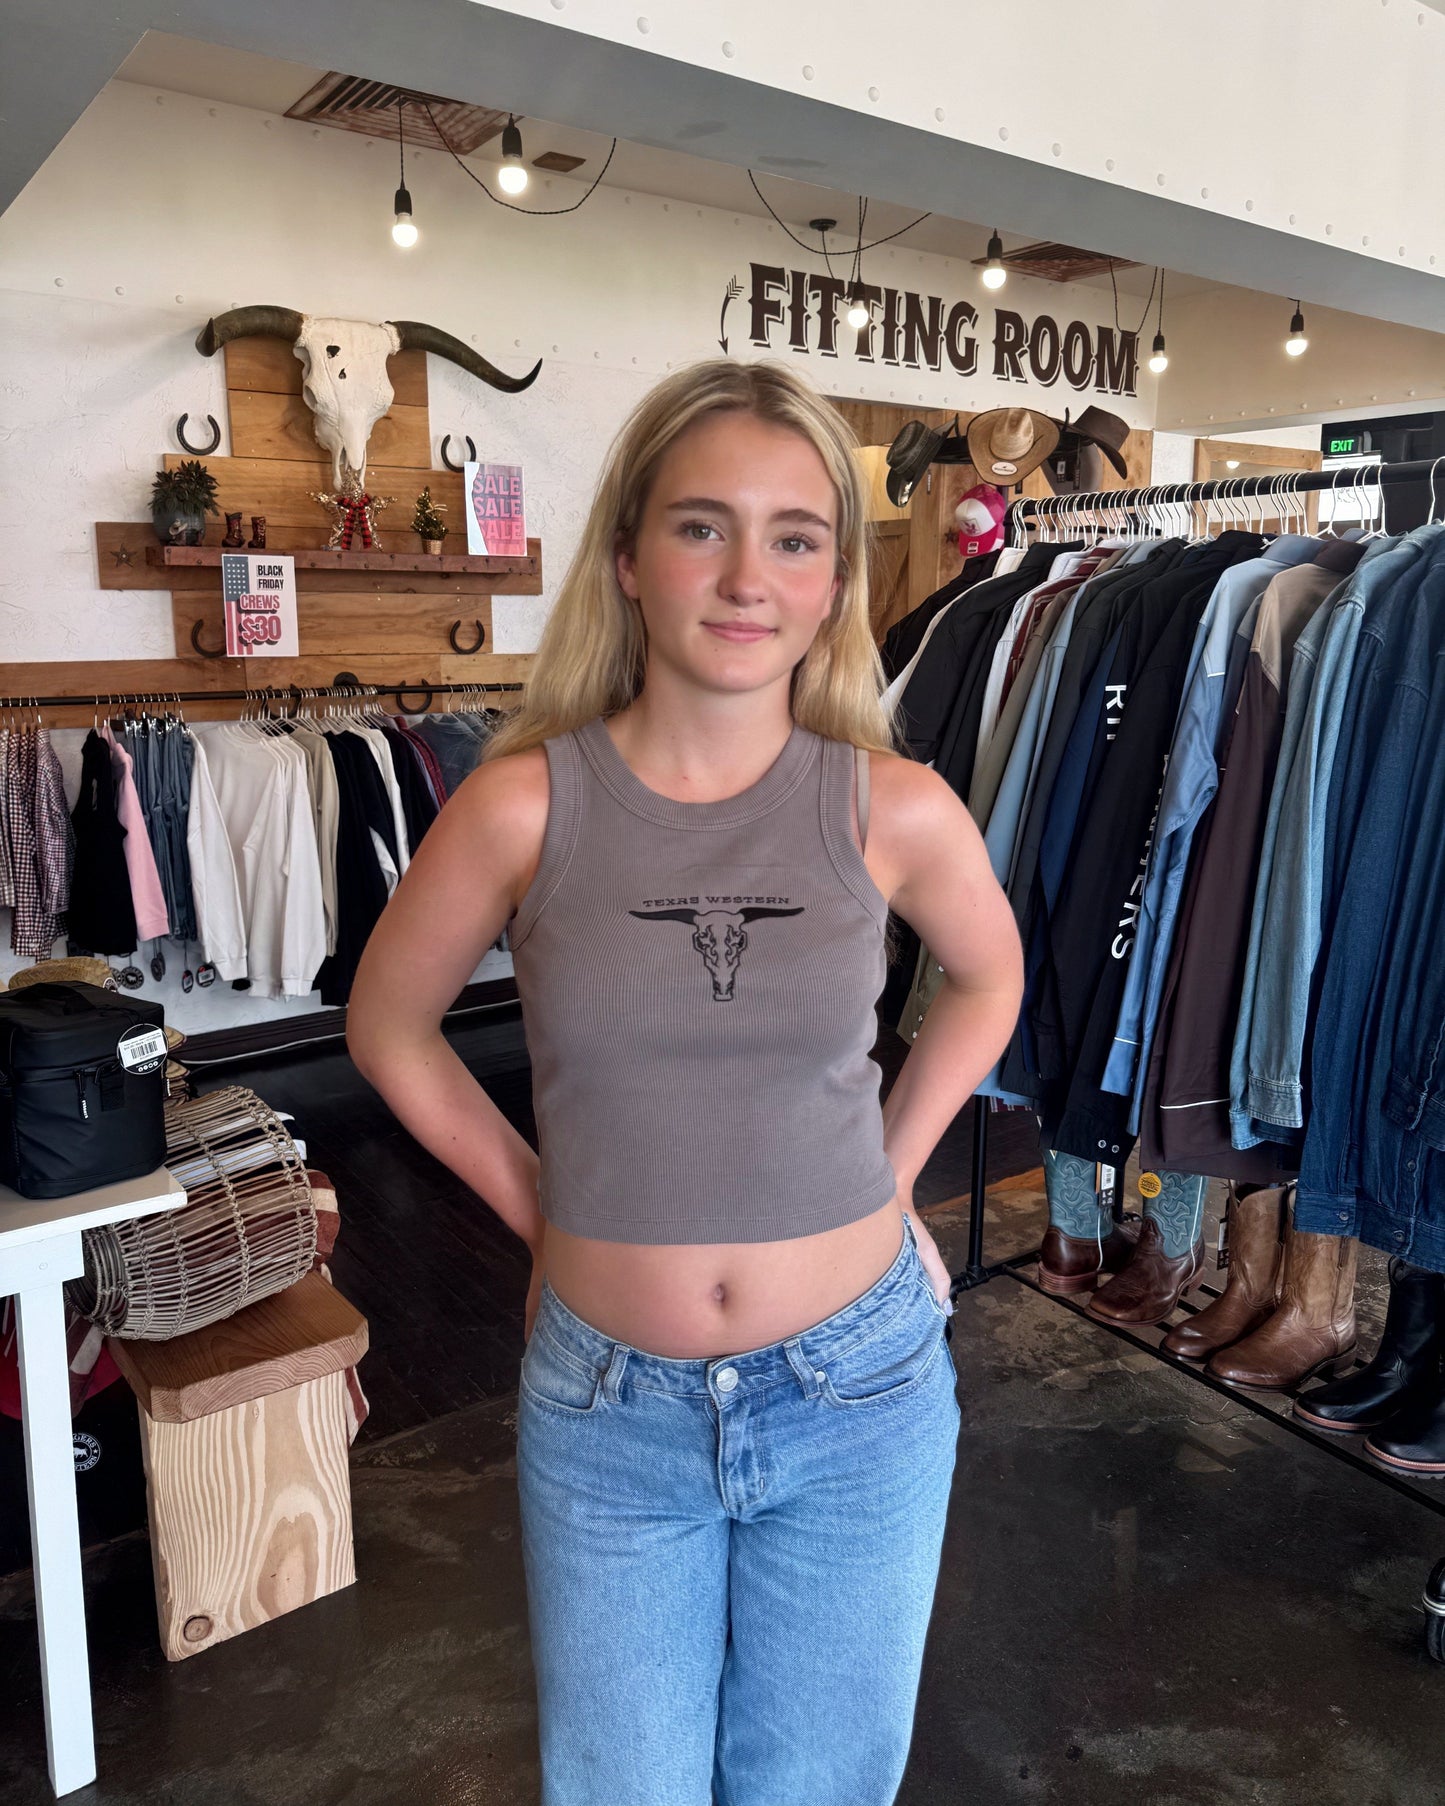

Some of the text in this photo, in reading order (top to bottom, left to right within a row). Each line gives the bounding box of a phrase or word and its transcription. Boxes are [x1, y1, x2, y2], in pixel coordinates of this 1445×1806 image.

[748, 262, 1141, 398] FITTING ROOM
[1330, 439, 1355, 453] EXIT
[473, 472, 521, 496] SALE
[473, 496, 523, 518] SALE
[257, 564, 284, 576] BLACK
[258, 578, 285, 590] FRIDAY
[240, 594, 281, 610] CREWS
[242, 614, 282, 642] $30
[642, 895, 790, 908] TEXAS WESTERN
